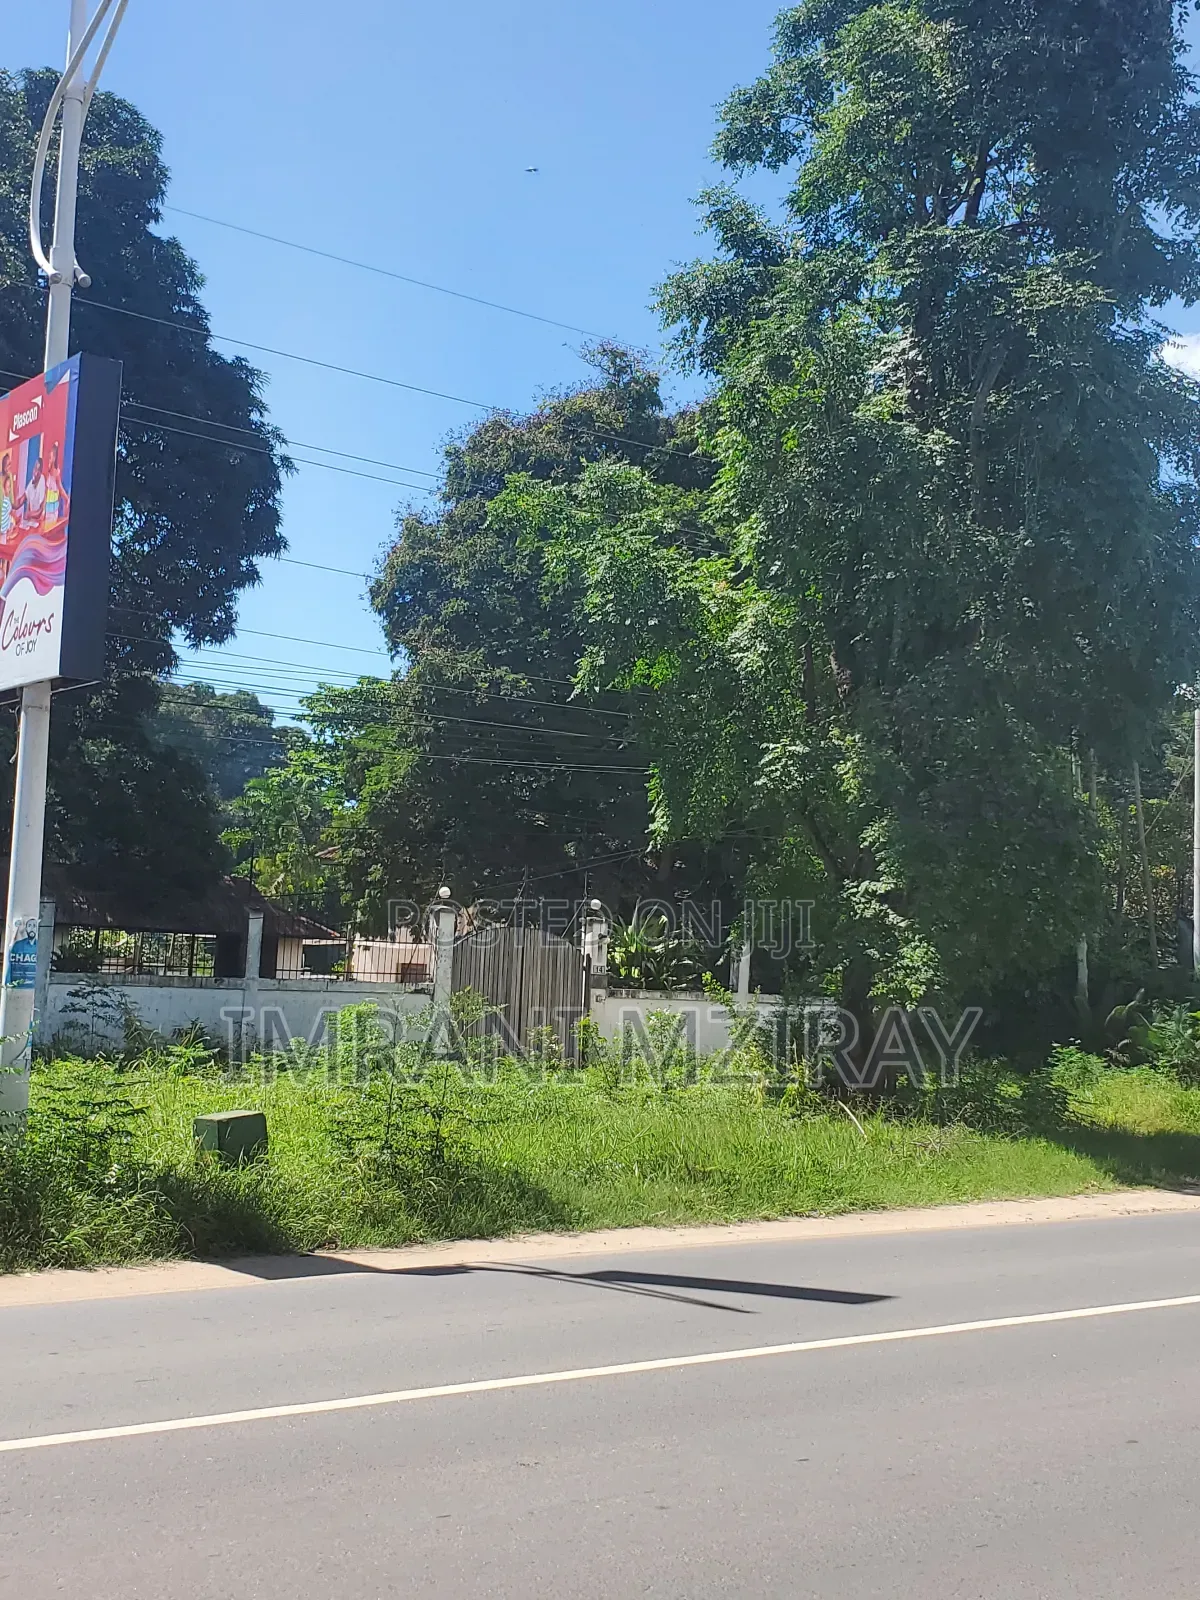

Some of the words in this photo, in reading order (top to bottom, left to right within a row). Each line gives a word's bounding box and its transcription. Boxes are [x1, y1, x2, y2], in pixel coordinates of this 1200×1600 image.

[13, 406, 38, 431] Plascon
[2, 602, 54, 651] Colours
[16, 642, 25, 656] OF
[25, 638, 37, 654] JOY
